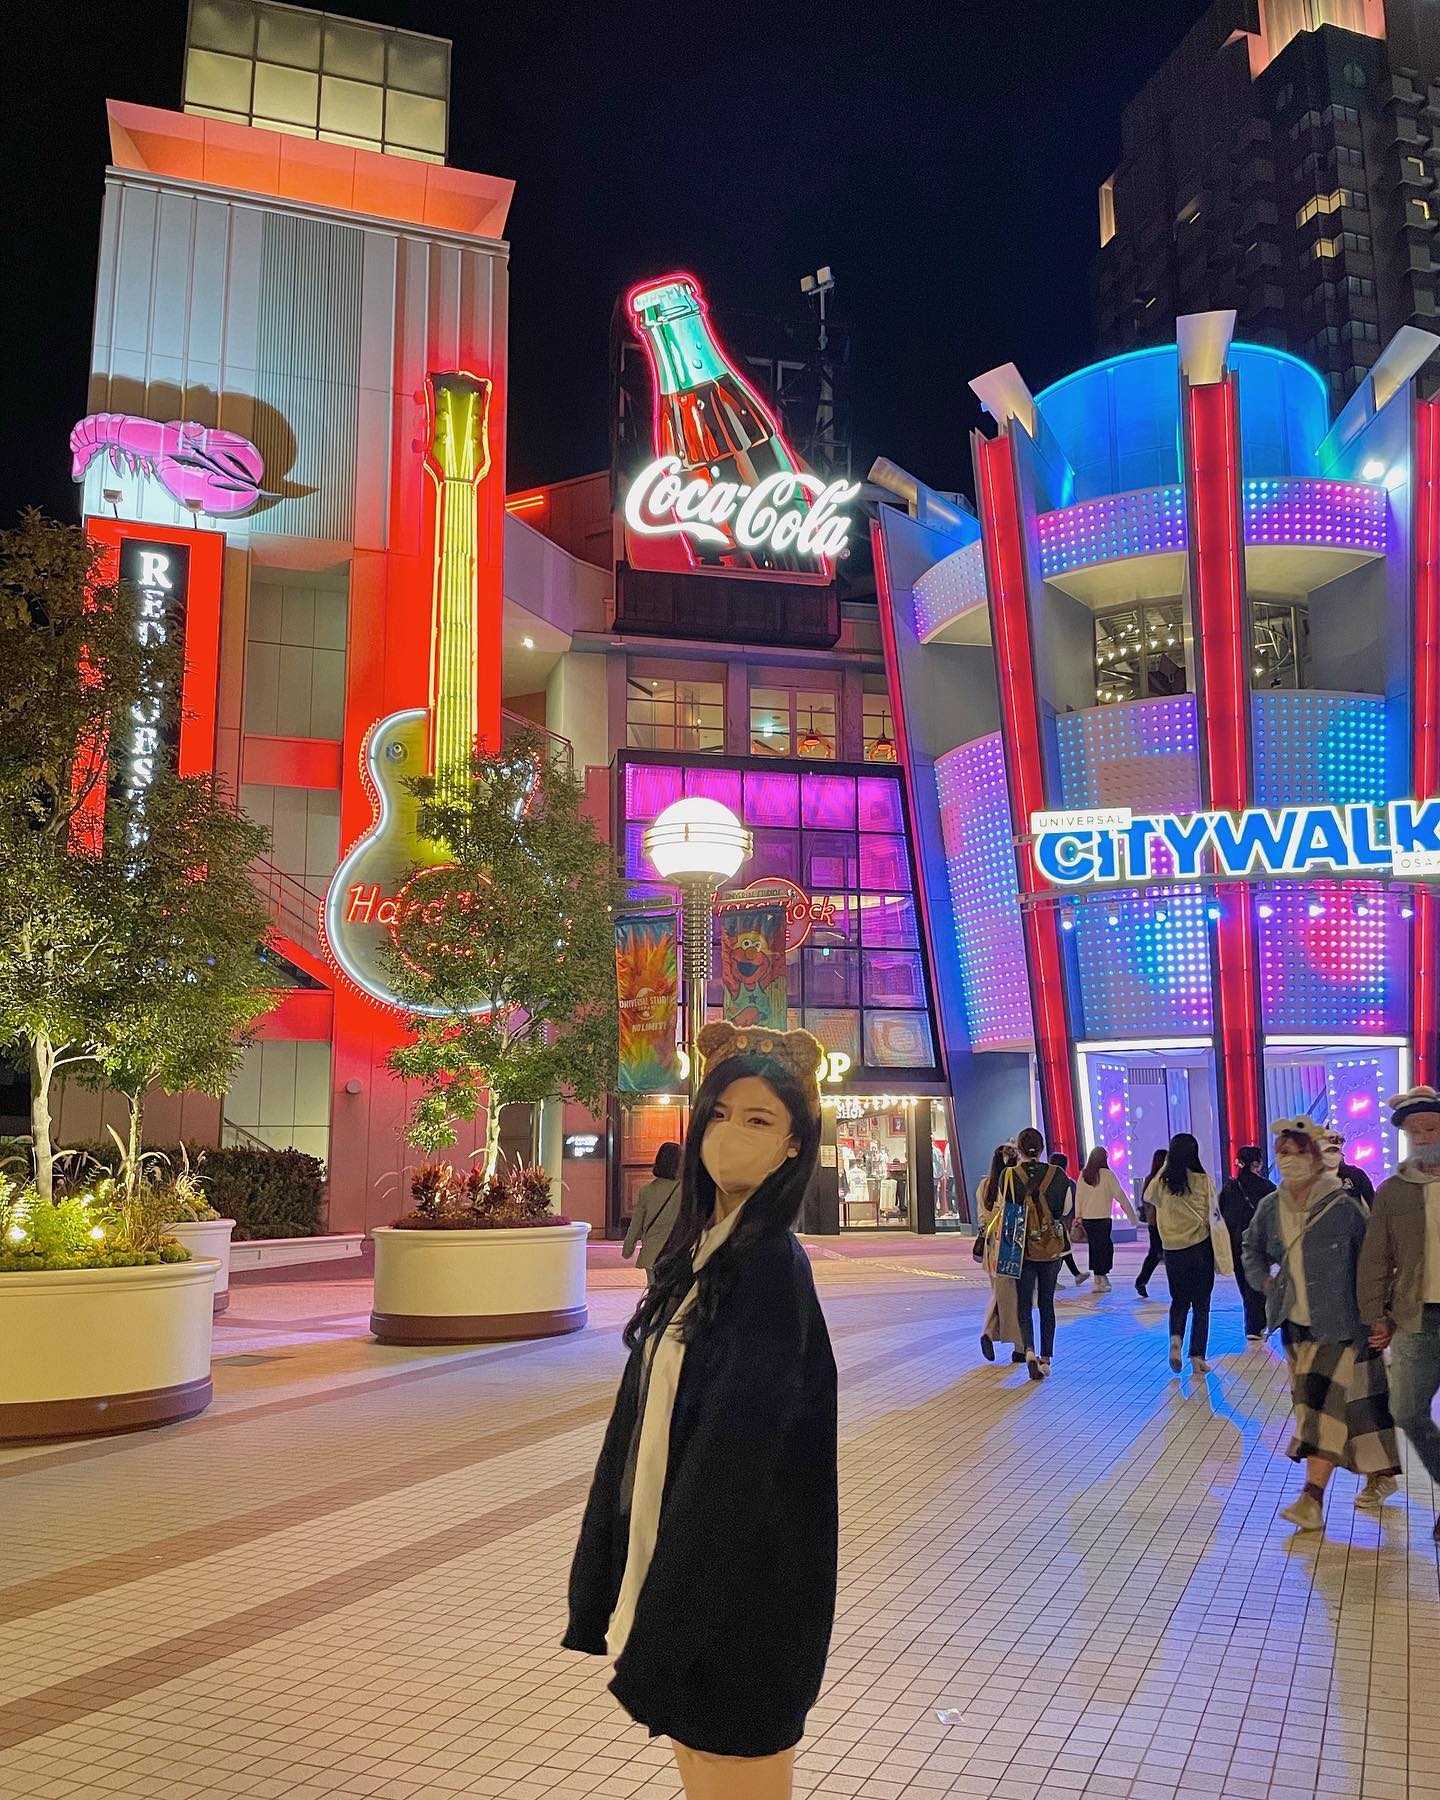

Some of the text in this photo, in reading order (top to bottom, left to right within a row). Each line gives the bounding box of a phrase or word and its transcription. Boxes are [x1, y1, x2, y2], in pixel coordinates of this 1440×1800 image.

[625, 456, 861, 556] Coca-Cola
[138, 551, 172, 648] RED
[1039, 815, 1124, 828] UNIVERSAL
[1400, 857, 1440, 869] OSA
